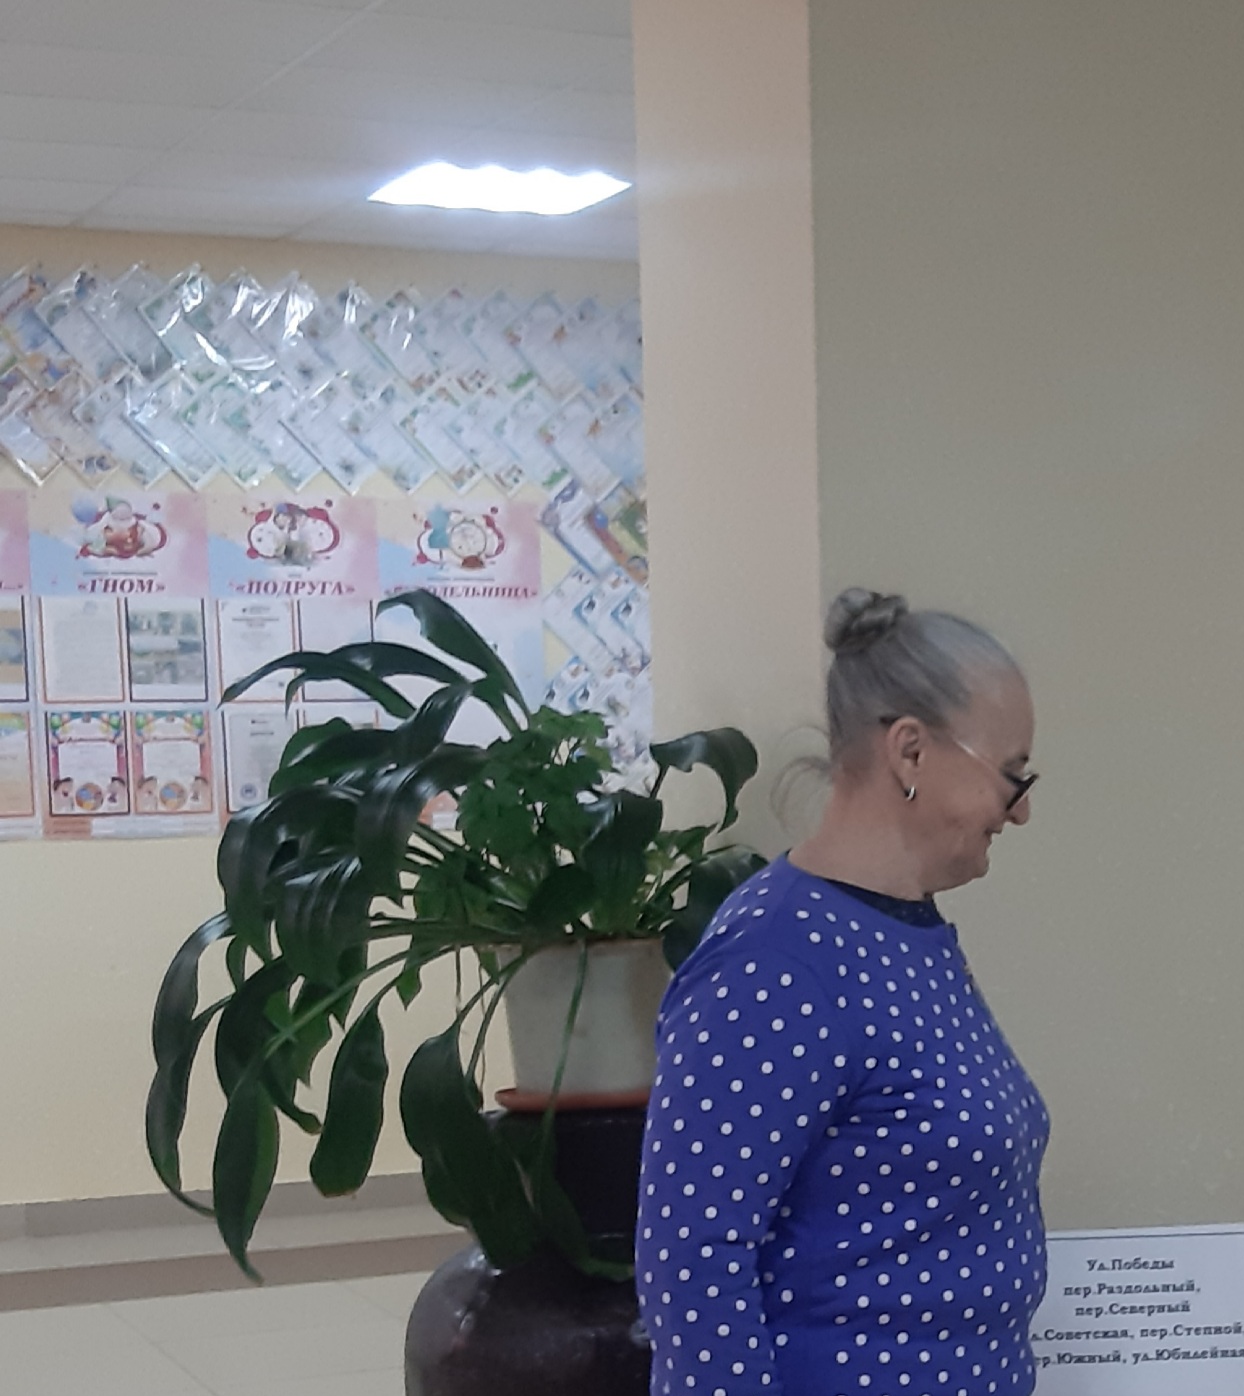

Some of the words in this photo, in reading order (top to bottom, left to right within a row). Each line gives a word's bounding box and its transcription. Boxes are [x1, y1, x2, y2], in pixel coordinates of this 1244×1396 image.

[78, 577, 165, 594] «ГНОМ»
[1074, 1301, 1191, 1318] пер.Северный
[1030, 1328, 1135, 1342] л.Советская,
[1033, 1350, 1127, 1369] ер.Южный,
